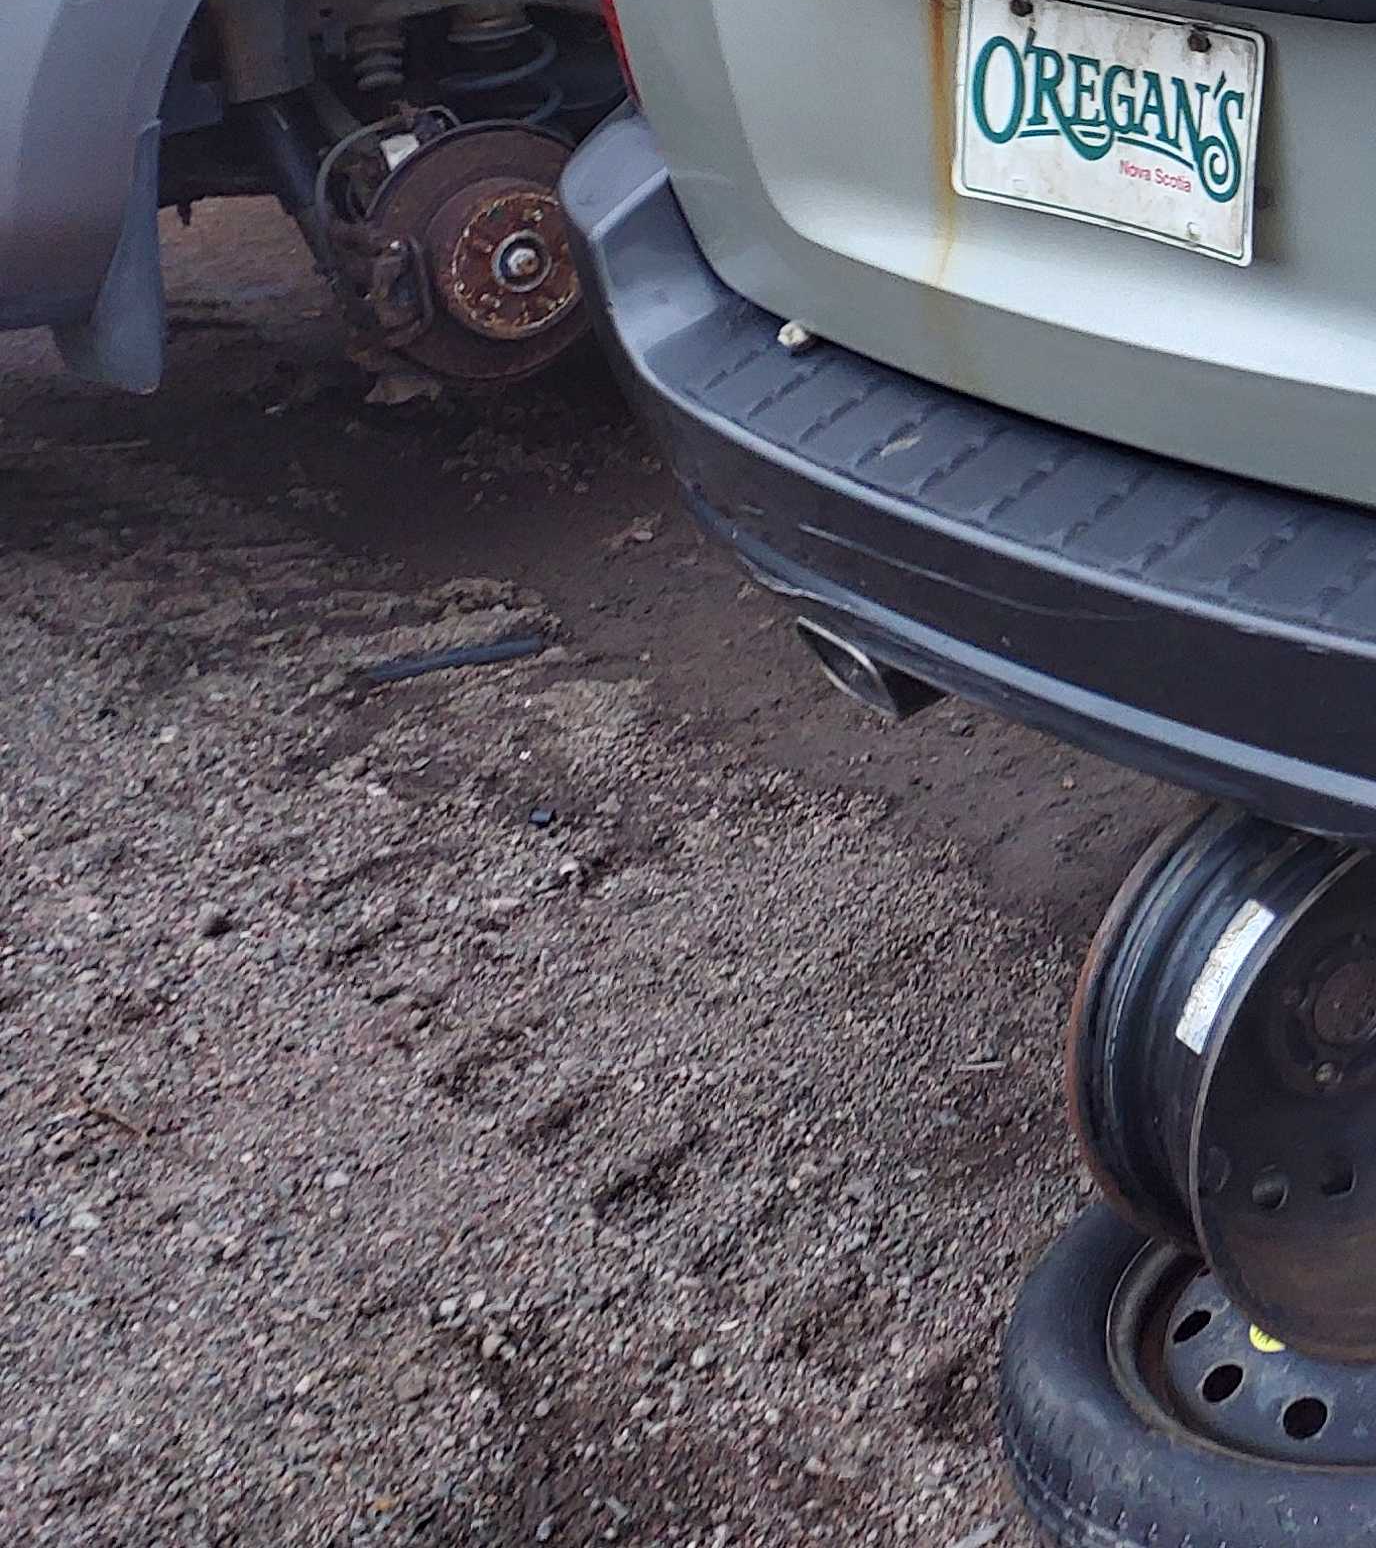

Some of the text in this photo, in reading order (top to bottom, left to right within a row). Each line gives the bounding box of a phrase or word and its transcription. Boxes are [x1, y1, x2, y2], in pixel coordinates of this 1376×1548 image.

[972, 27, 1245, 203] O'REGAN'S
[1119, 159, 1192, 193] Nova Scotia
